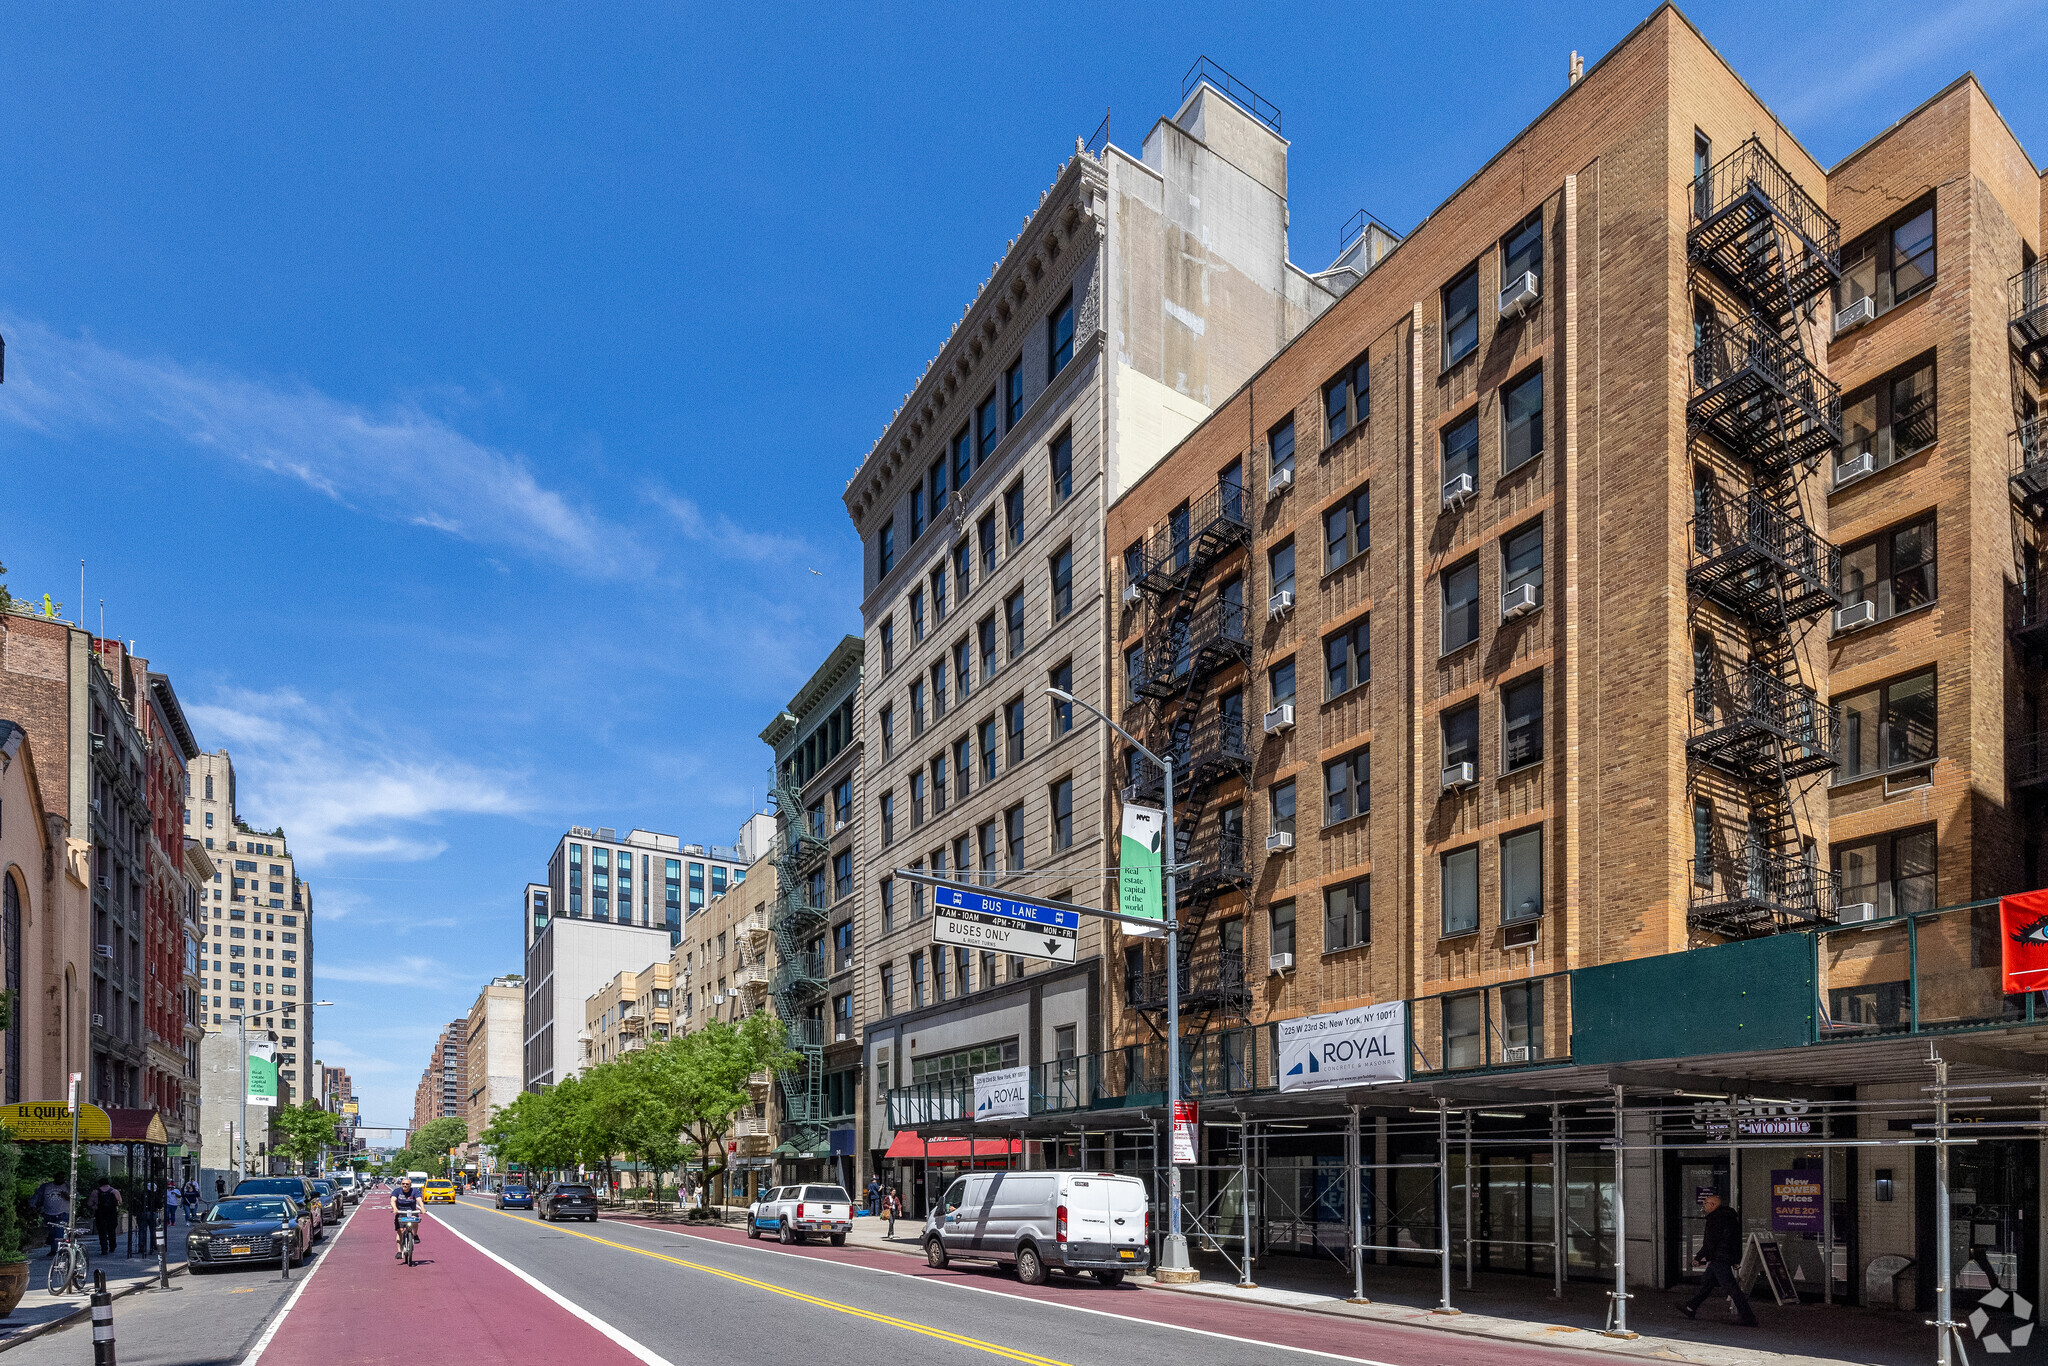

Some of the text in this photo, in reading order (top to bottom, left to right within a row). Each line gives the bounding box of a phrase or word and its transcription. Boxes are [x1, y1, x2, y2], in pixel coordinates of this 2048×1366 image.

[1136, 814, 1150, 822] NYC
[1124, 886, 1146, 894] capital
[982, 899, 1038, 918] BUS LANE
[949, 922, 1010, 941] BUSES ONLY
[1285, 1026, 1295, 1035] 225
[1304, 1022, 1317, 1032] 23rd
[1329, 1020, 1343, 1028] New
[1344, 1016, 1362, 1026] York,
[1364, 1014, 1374, 1022] NY
[1376, 1010, 1396, 1020] 10011
[1324, 1035, 1395, 1063] ROYAL
[1324, 1063, 1354, 1072] CONCRETE
[994, 1087, 1025, 1103] ROYAL
[18, 1106, 30, 1117] EL
[1318, 1160, 1371, 1176] RETL
[1320, 1192, 1368, 1208] LEAE
[1961, 1206, 1999, 1219] 225
